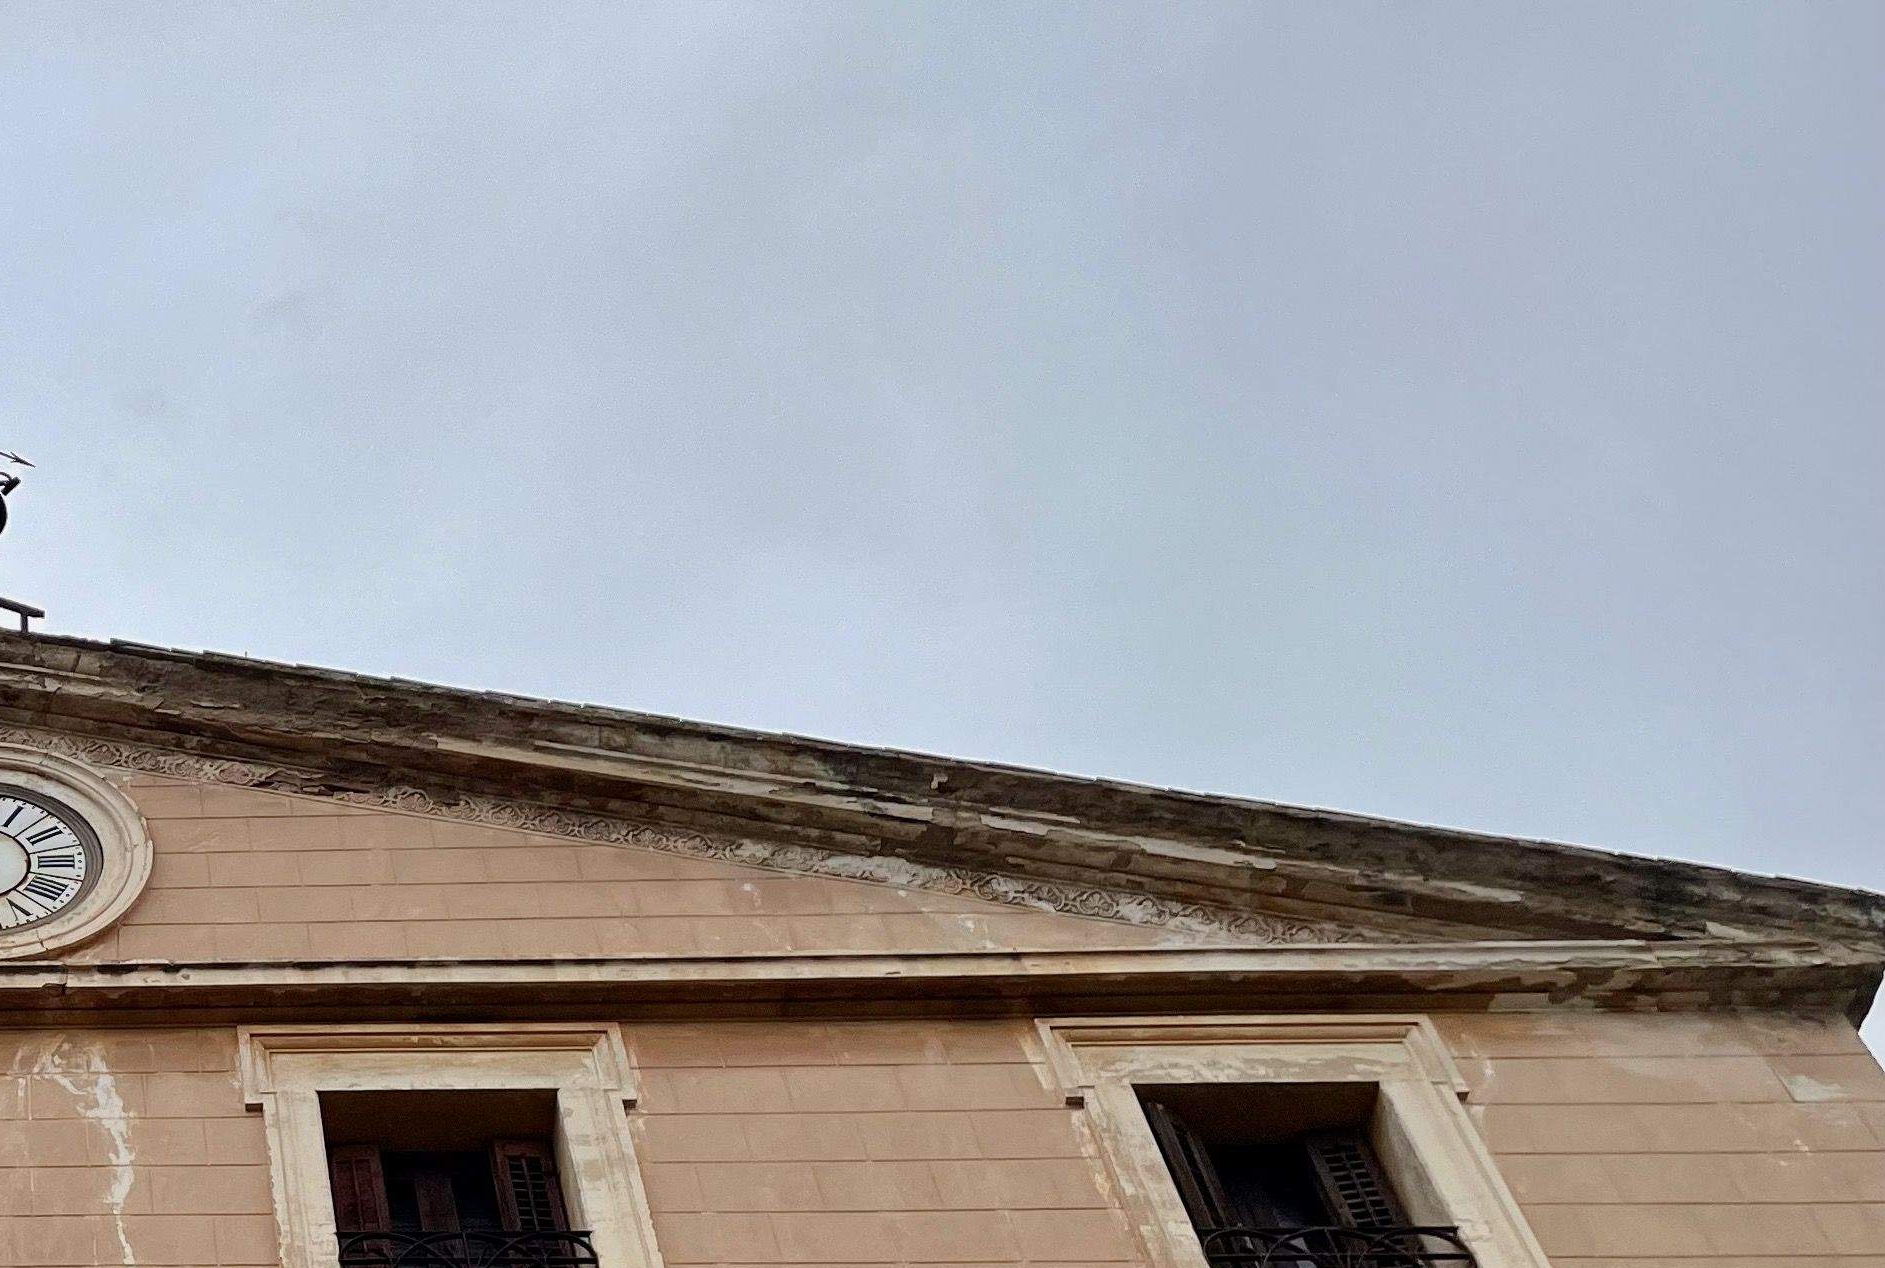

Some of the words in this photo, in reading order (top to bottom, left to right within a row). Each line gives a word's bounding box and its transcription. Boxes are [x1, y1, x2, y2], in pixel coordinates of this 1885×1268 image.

[2, 805, 24, 828] I
[25, 825, 64, 846] II
[37, 853, 76, 869] III
[22, 874, 68, 901] IIII
